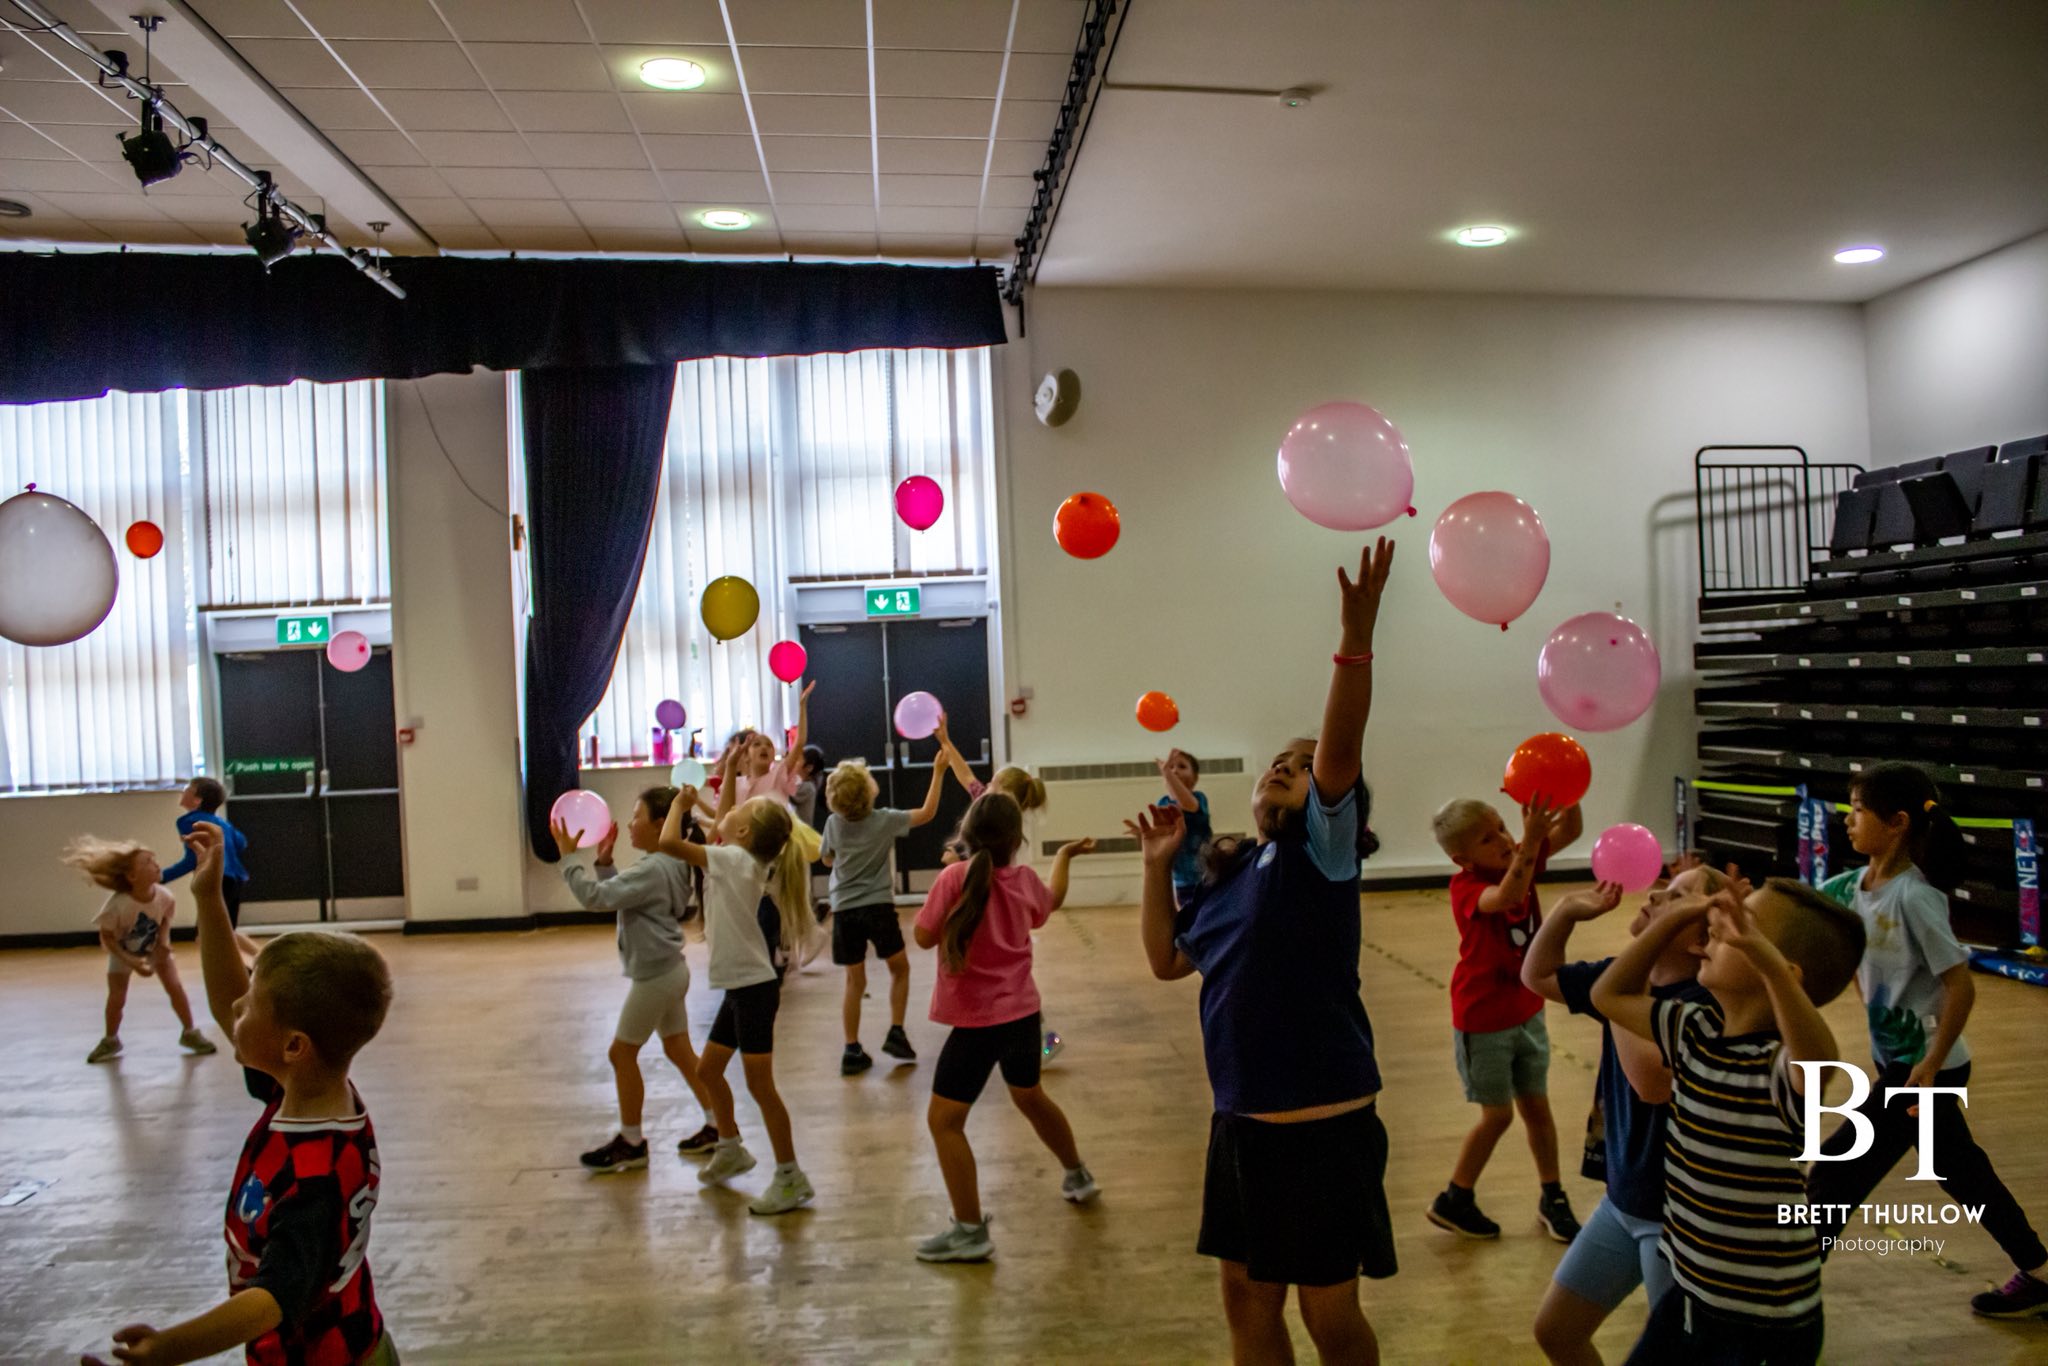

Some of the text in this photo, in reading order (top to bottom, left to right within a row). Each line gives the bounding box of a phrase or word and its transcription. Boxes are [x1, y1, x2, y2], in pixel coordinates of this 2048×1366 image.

[237, 761, 315, 771] Push bar to open
[2016, 847, 2039, 889] NET
